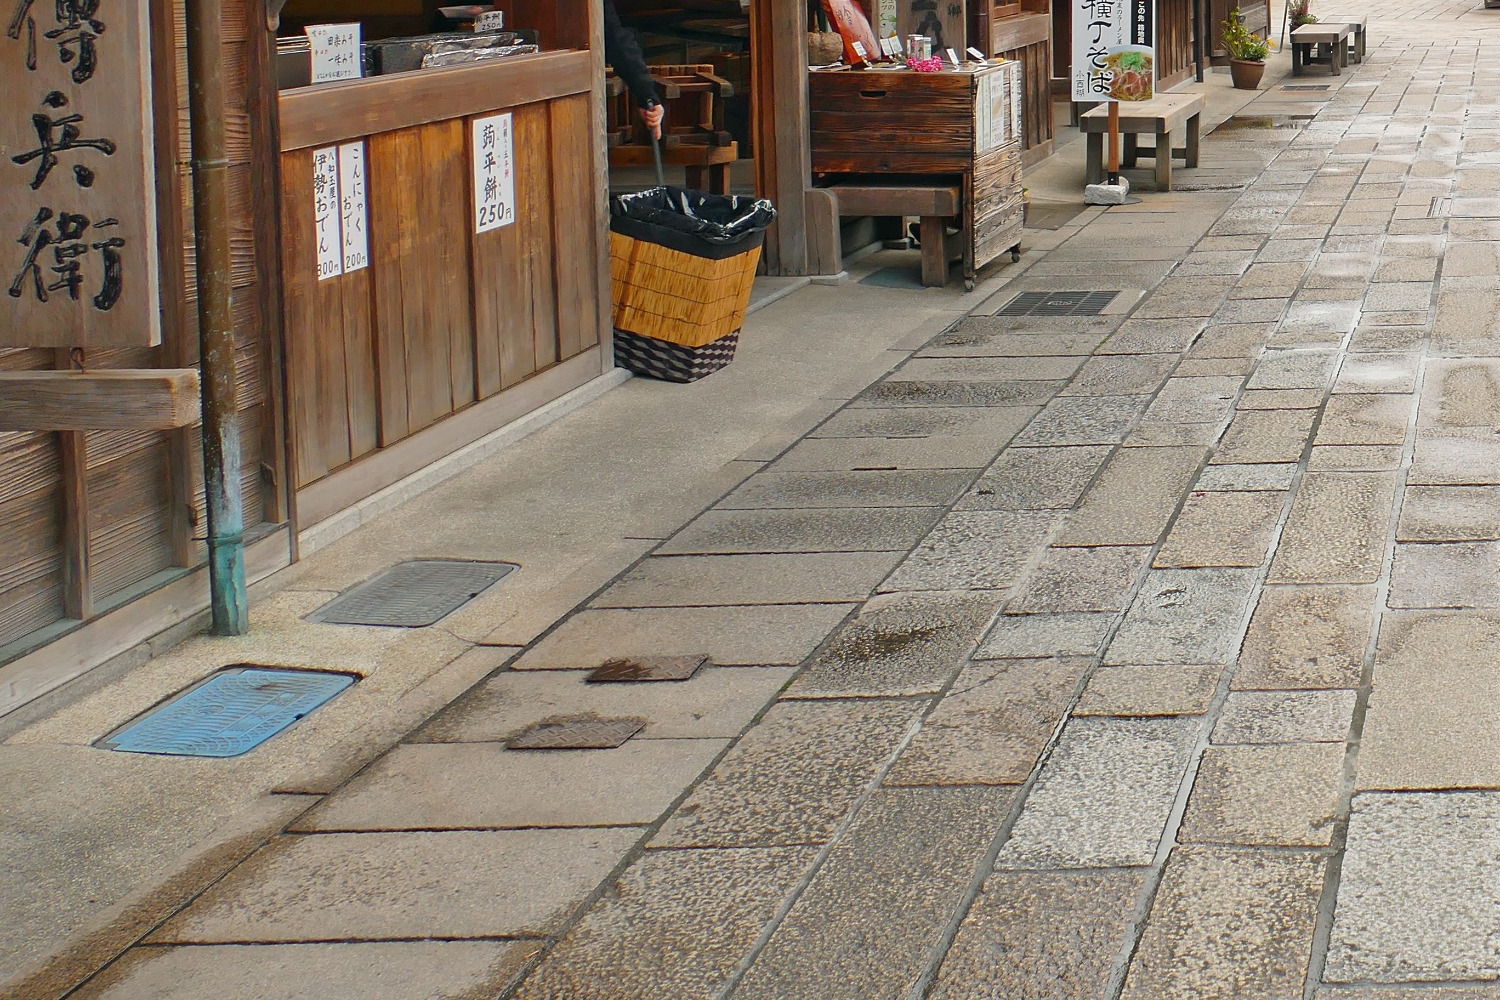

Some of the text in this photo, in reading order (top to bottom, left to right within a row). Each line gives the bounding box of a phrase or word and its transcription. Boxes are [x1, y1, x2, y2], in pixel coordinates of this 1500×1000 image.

[352, 148, 364, 232] こんにゃく
[482, 123, 498, 203] 蒟平餅
[313, 153, 330, 254] 伊勢おでん
[343, 195, 353, 247] おでん
[479, 201, 512, 227] 250円
[345, 252, 366, 270] 200円
